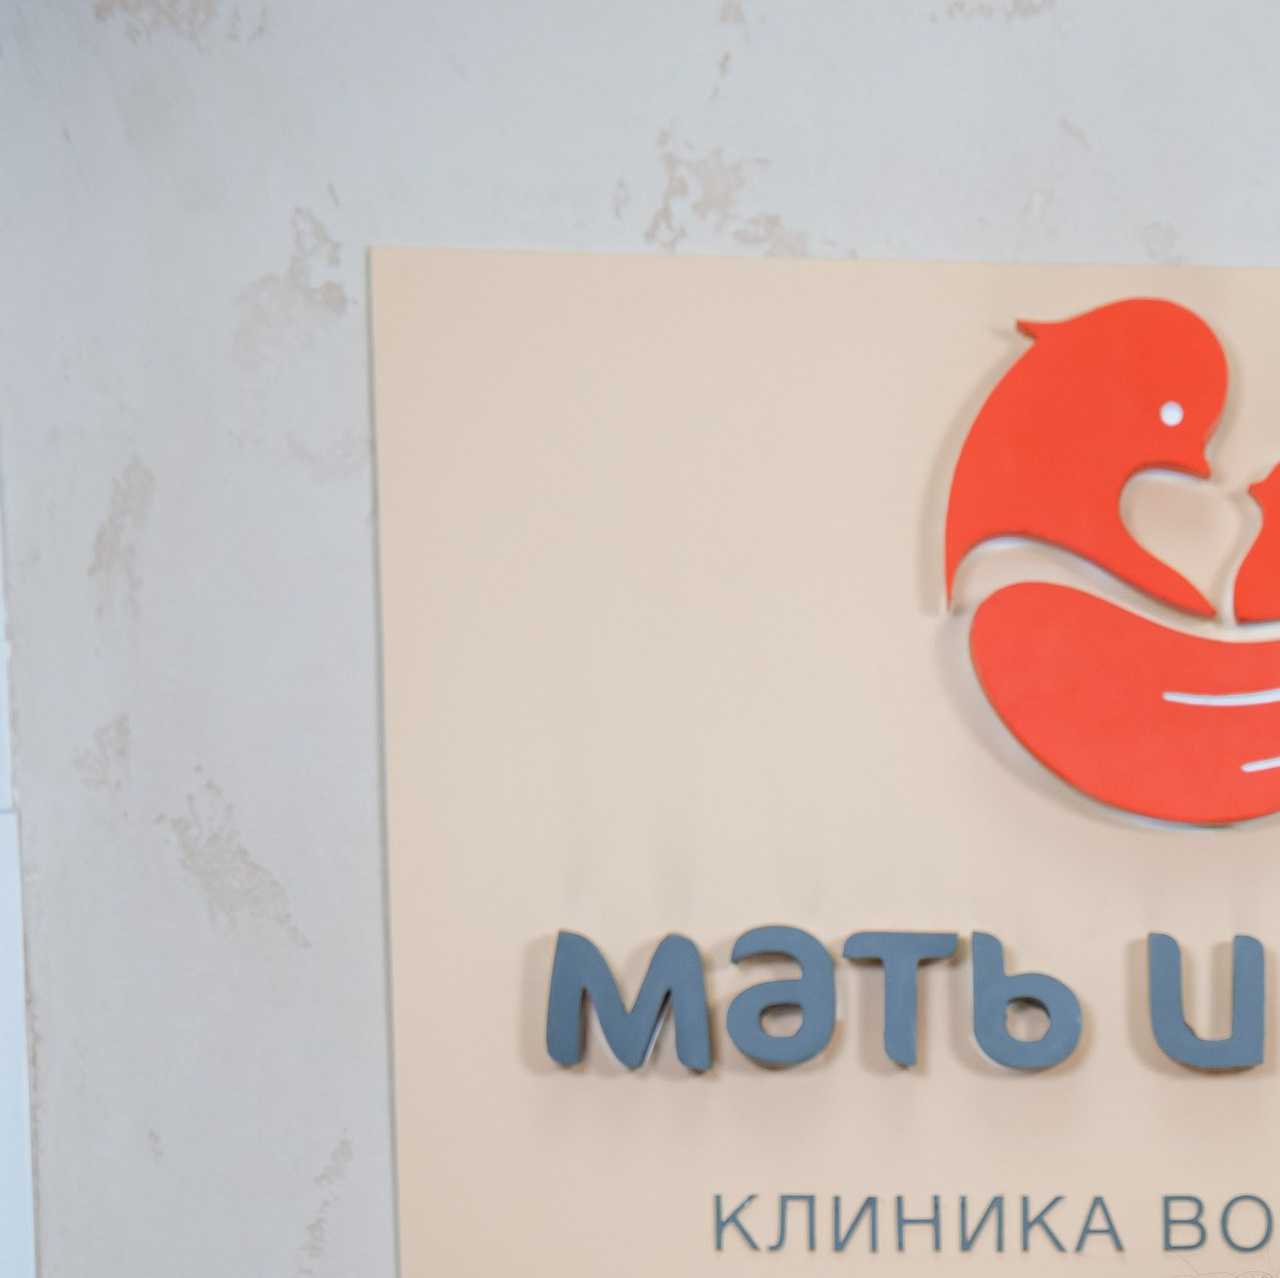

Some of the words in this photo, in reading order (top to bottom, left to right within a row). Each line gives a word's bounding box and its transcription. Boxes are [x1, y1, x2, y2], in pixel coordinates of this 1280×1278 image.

[545, 925, 1082, 1072] мать
[1148, 932, 1265, 1068] и
[713, 1195, 1125, 1253] КЛИНИКА
